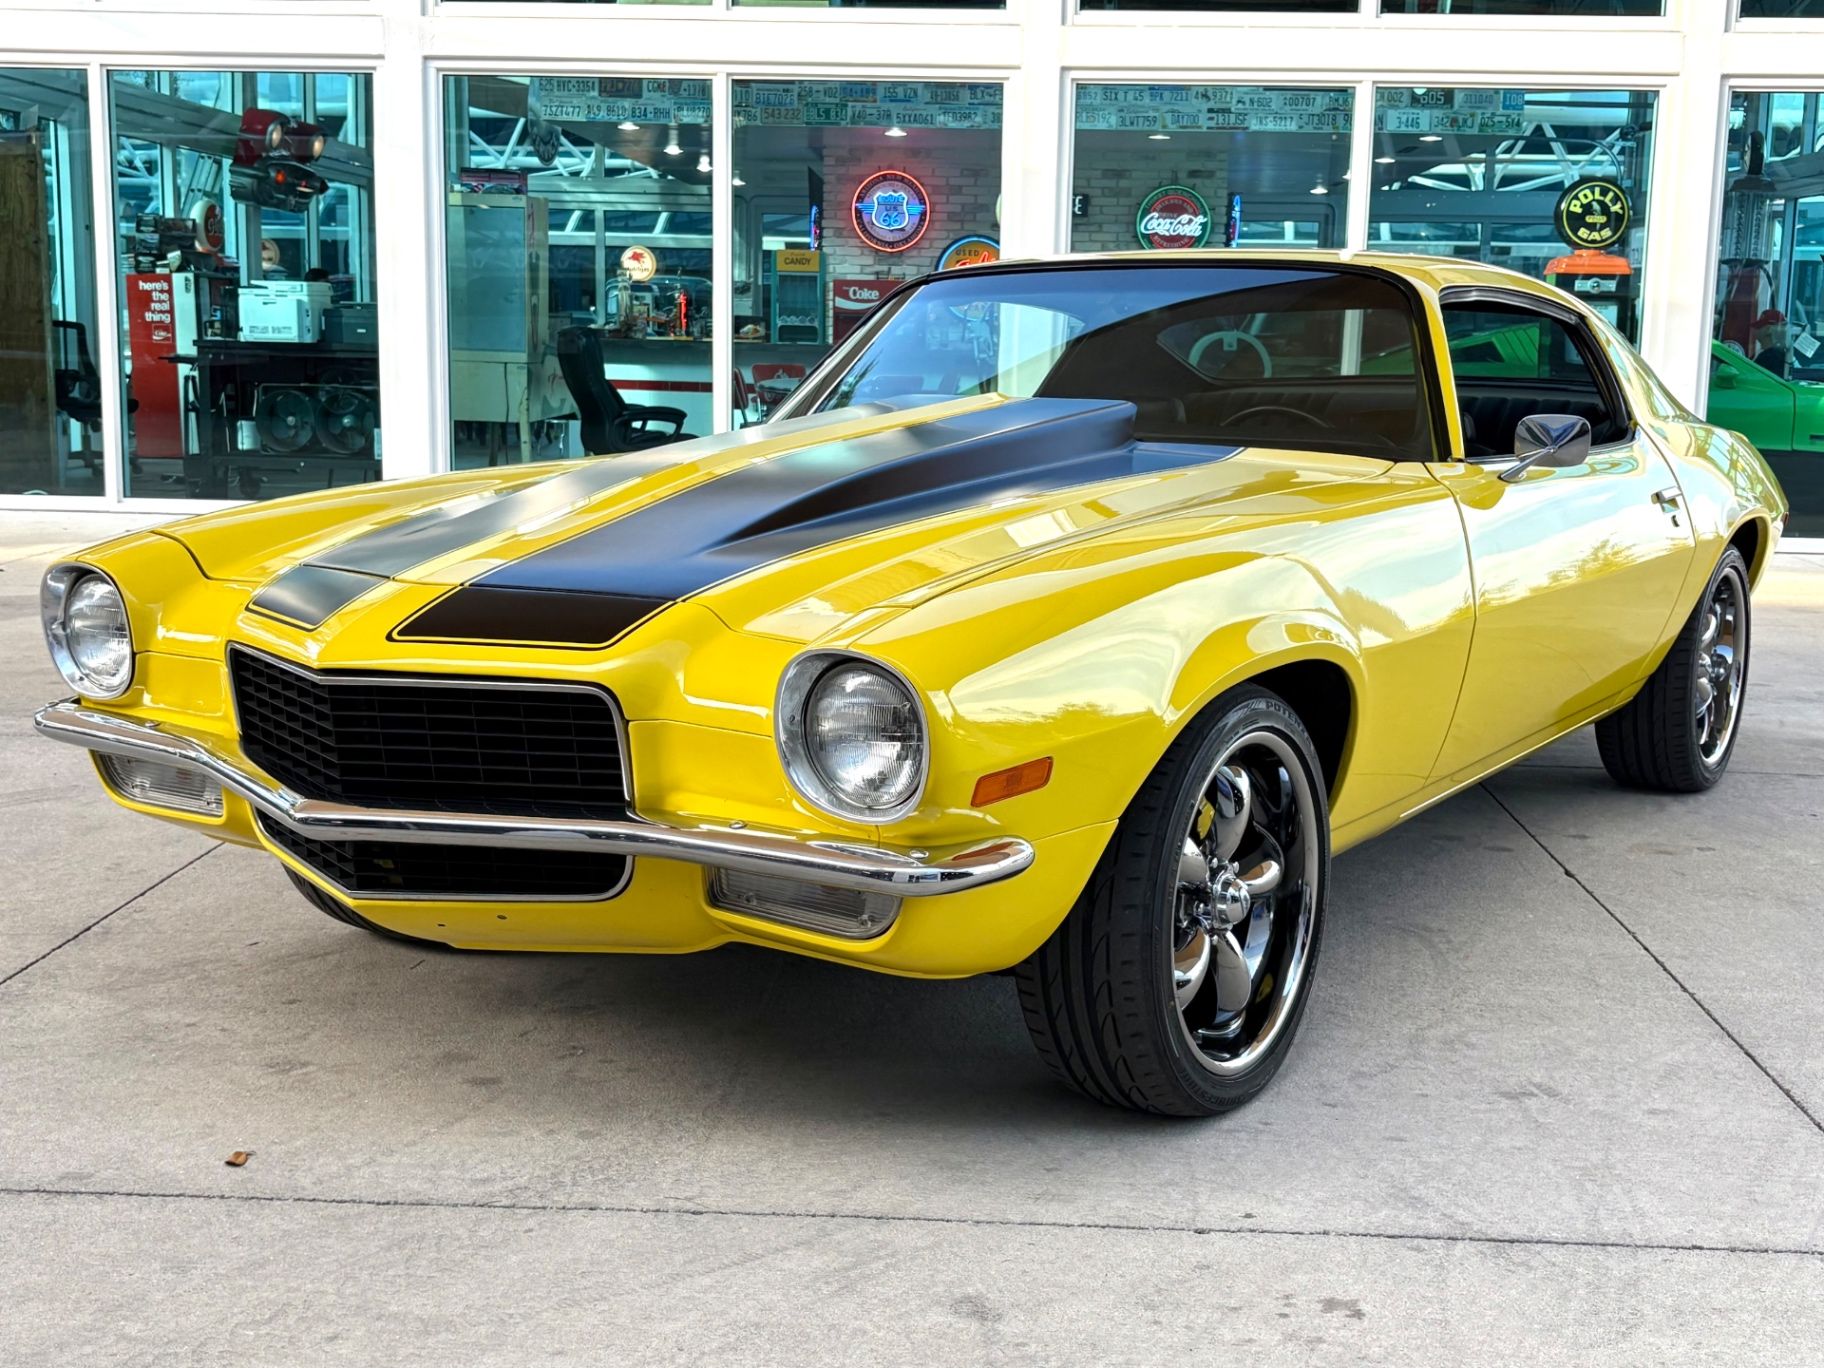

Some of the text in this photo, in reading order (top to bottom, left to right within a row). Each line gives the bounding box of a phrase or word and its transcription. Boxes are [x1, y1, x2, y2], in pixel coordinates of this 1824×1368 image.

[878, 194, 905, 202] ROUTE
[1569, 186, 1624, 214] POLLY
[880, 212, 900, 226] 66
[1140, 212, 1208, 237] Coca-Cola
[1577, 227, 1612, 241] GAS
[784, 257, 812, 266] CANDY
[138, 280, 168, 290] here's
[152, 291, 170, 300] the
[848, 286, 880, 300] Coke
[151, 300, 170, 310] real
[144, 312, 170, 324] thing
